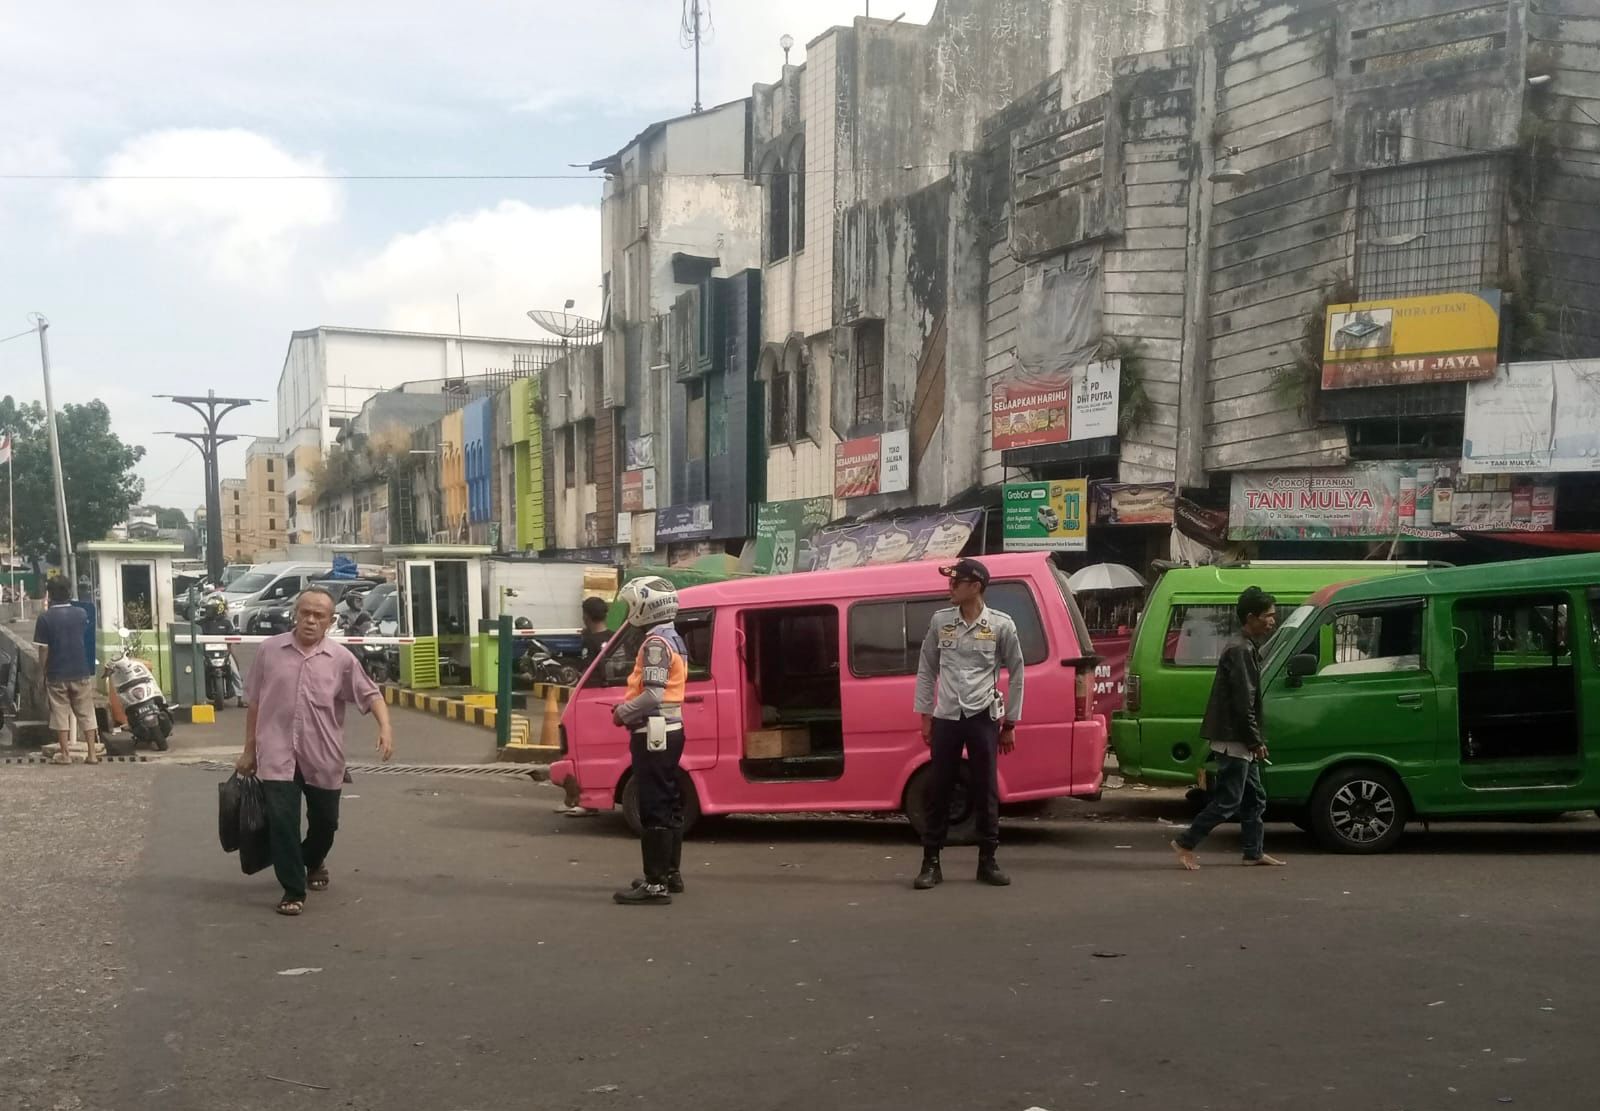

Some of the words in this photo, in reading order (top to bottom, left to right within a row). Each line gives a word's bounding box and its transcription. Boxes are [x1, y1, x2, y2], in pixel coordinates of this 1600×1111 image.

[1431, 355, 1481, 370] JAYA
[1090, 381, 1099, 391] PD
[1037, 390, 1067, 404] HARIMU
[1090, 390, 1113, 402] PUTRA
[1279, 478, 1303, 488] TOKO
[1304, 477, 1353, 488] PERTANIAN
[1063, 492, 1080, 519] 11
[1246, 490, 1295, 510] TANI
[1299, 490, 1375, 510] MULYA
[775, 546, 789, 567] 63
